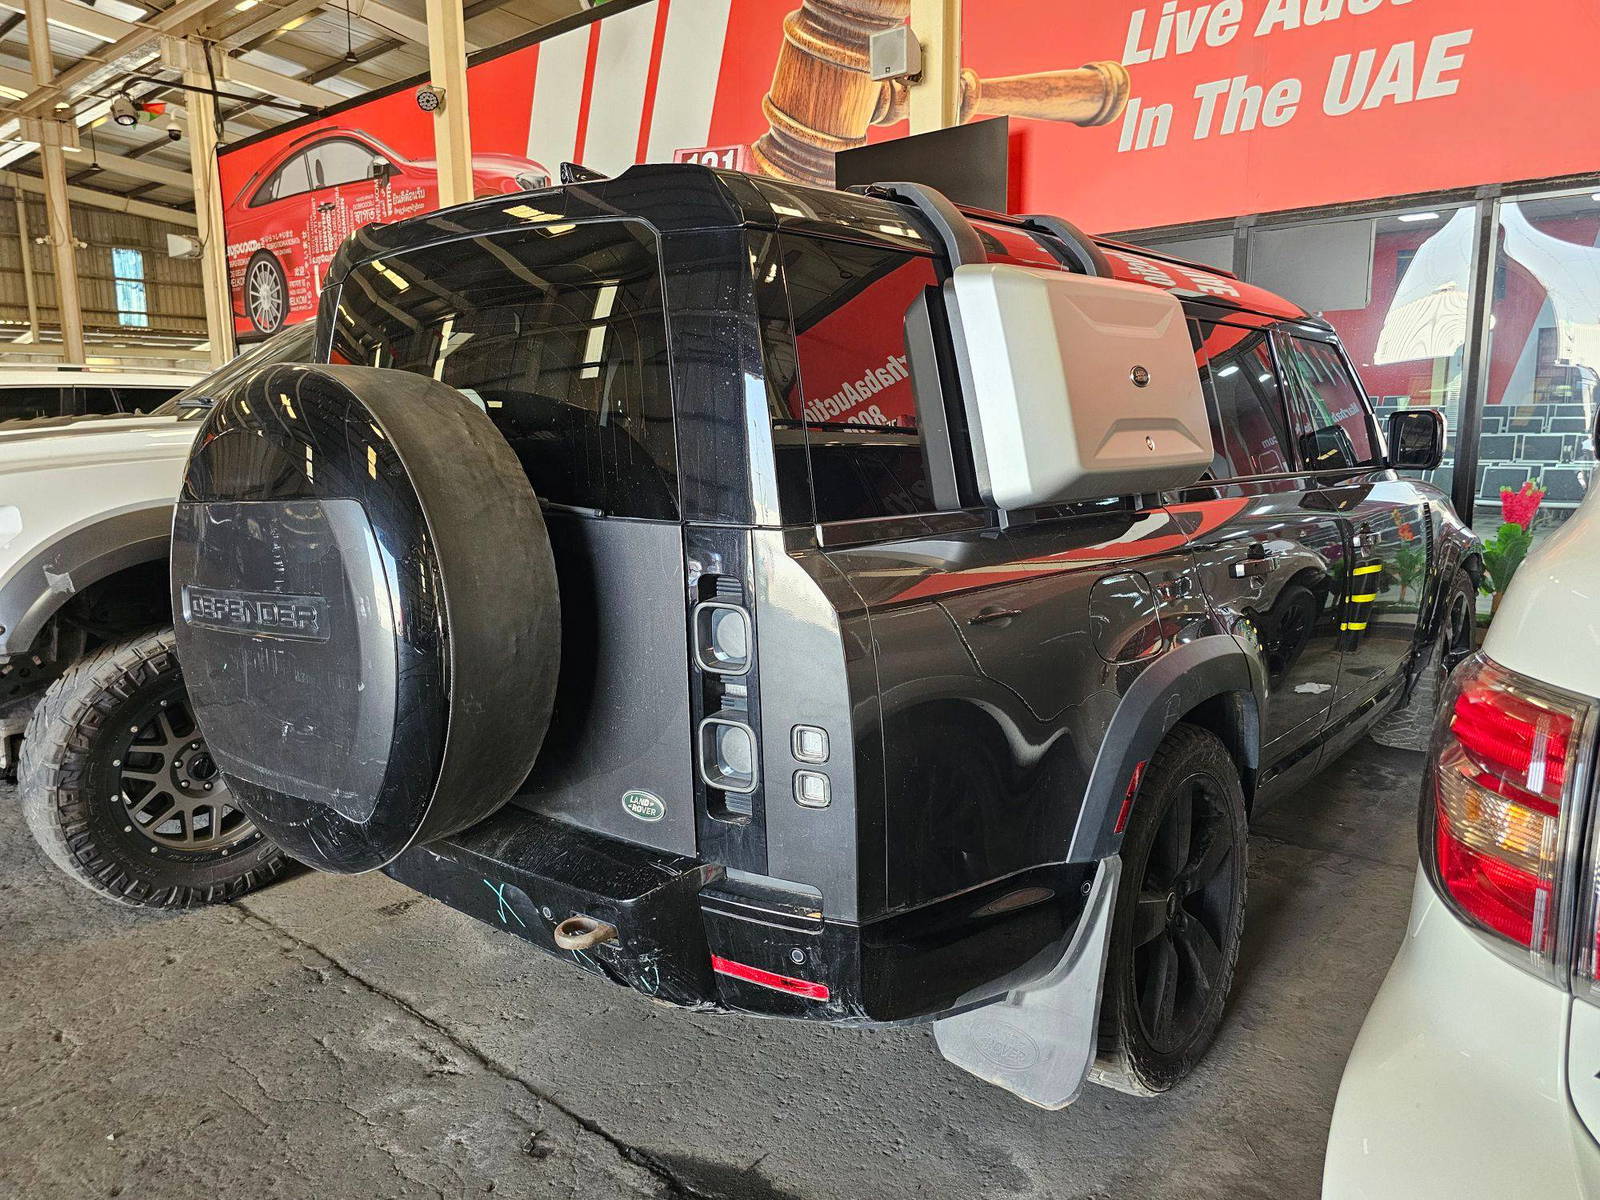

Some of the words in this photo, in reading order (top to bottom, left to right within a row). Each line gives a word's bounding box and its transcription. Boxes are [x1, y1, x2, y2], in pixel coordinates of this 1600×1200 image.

[1121, 0, 1243, 66] Live
[1254, 0, 1414, 37] Au
[1117, 98, 1174, 153] In
[1193, 76, 1302, 140] The
[1322, 29, 1473, 117] UAE
[192, 597, 319, 631] DEFENDER
[629, 795, 650, 807] LAND
[631, 803, 657, 816] ROVER
